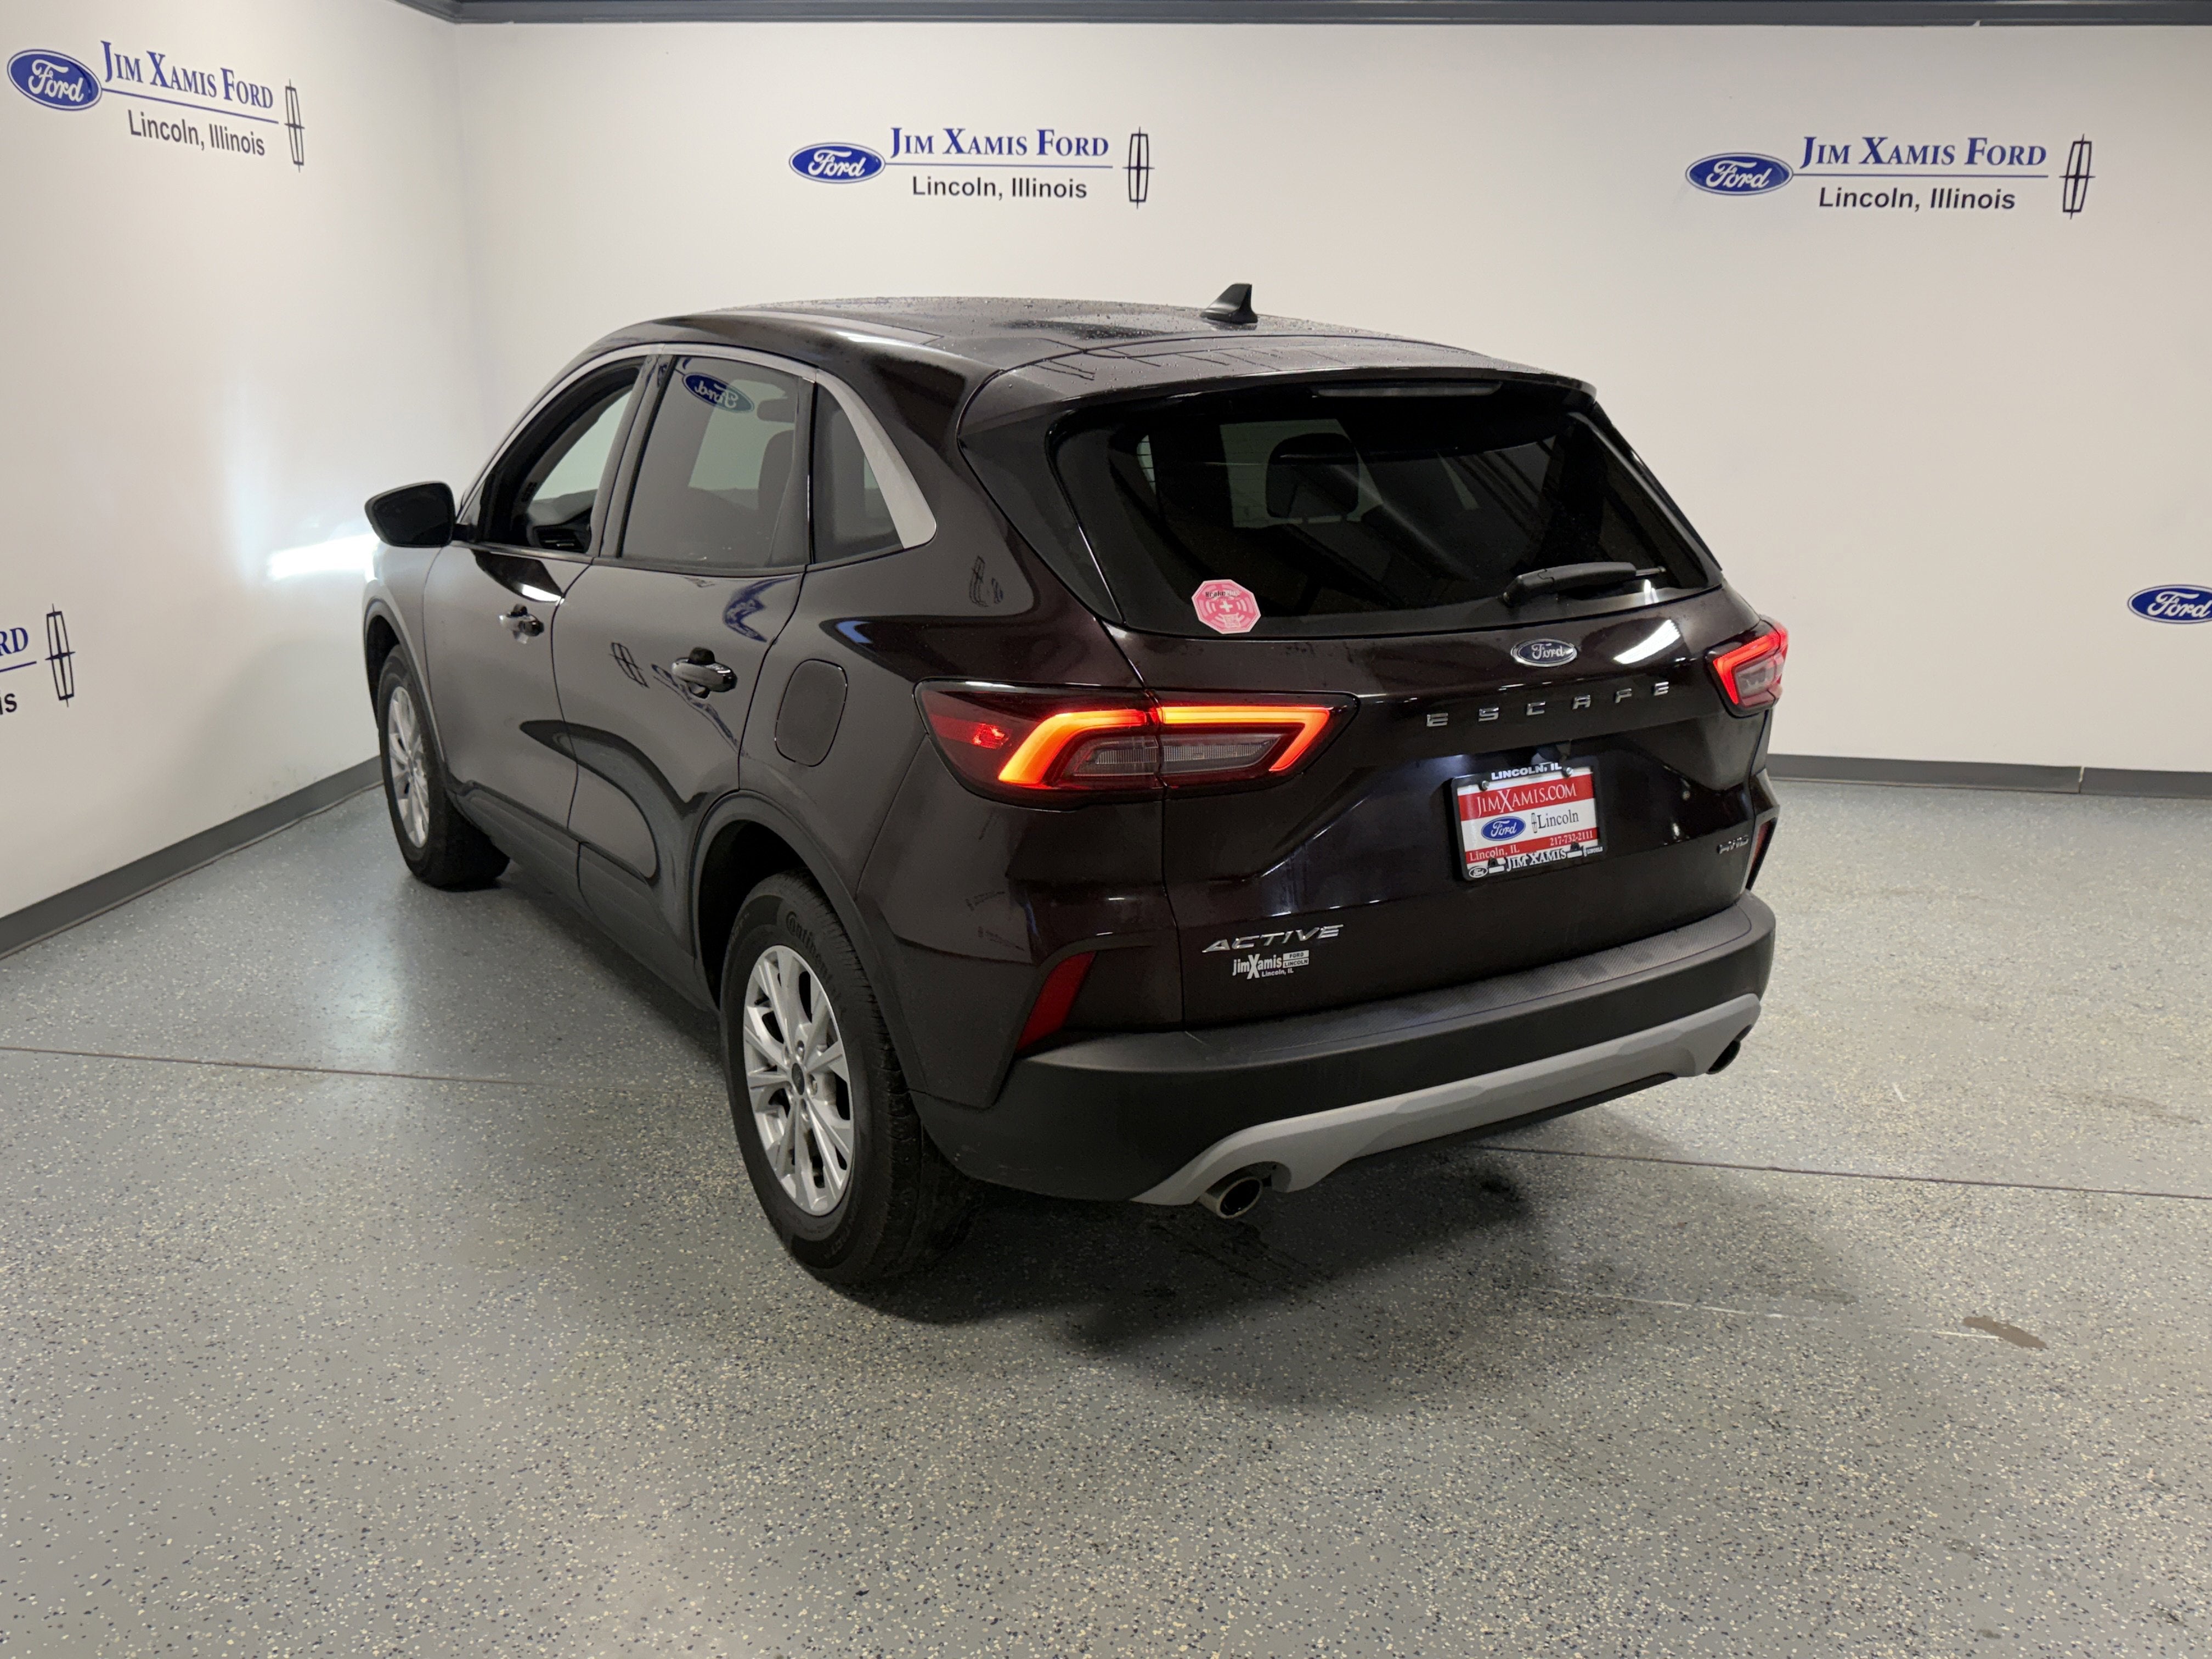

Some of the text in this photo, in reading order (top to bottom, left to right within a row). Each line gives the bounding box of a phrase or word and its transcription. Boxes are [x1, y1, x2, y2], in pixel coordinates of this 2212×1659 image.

[28, 59, 84, 103] Ford
[101, 41, 273, 109] JIM XAMIS FORD
[128, 109, 265, 156] Lincoln, Illinois
[890, 127, 1109, 159] JIM XAMIS FORD
[808, 149, 866, 177] Ford
[1799, 137, 2046, 170] JIM XAMIS FORD
[1706, 160, 1773, 188] Ford
[913, 176, 1087, 201] Lincoln, Illinois
[1819, 187, 2015, 212] Lincoln, Illinois
[2147, 591, 2211, 618] Ford
[1531, 642, 1565, 660] Ford
[1426, 681, 1669, 727] ESCAPE
[1491, 762, 1562, 780] LINCOLN, IL
[1490, 820, 1517, 838] Ford
[1538, 810, 1579, 829] Lincoln
[1549, 830, 1593, 847] 217-732-2111
[1469, 844, 1520, 861] Lincoln, IL
[1506, 849, 1567, 872] JIM XAMIS
[1202, 924, 1344, 953] ACTIVE
[1262, 969, 1286, 977] Lincoln,
